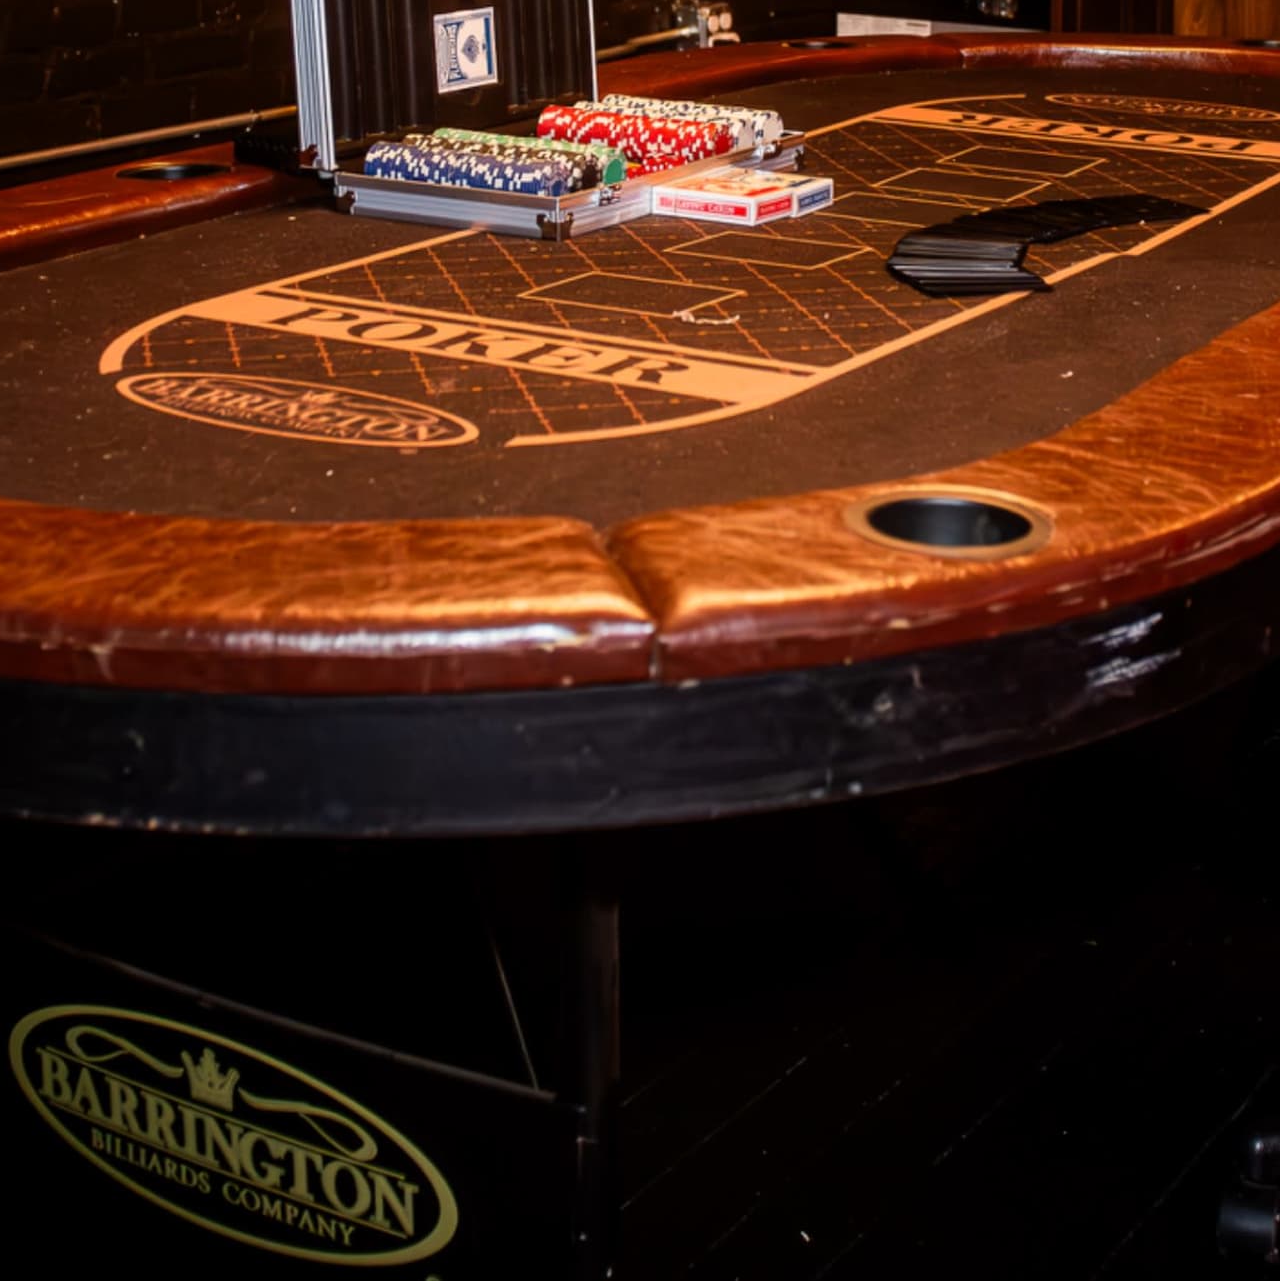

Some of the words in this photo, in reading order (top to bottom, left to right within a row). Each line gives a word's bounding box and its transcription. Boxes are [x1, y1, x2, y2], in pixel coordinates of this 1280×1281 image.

[948, 112, 1253, 152] POKER
[270, 306, 690, 384] POKER
[134, 379, 449, 441] BARRINGTON
[37, 1049, 419, 1236] BARRINGTON
[91, 1129, 211, 1195] BILLIARDS
[222, 1182, 356, 1246] COMPANY
